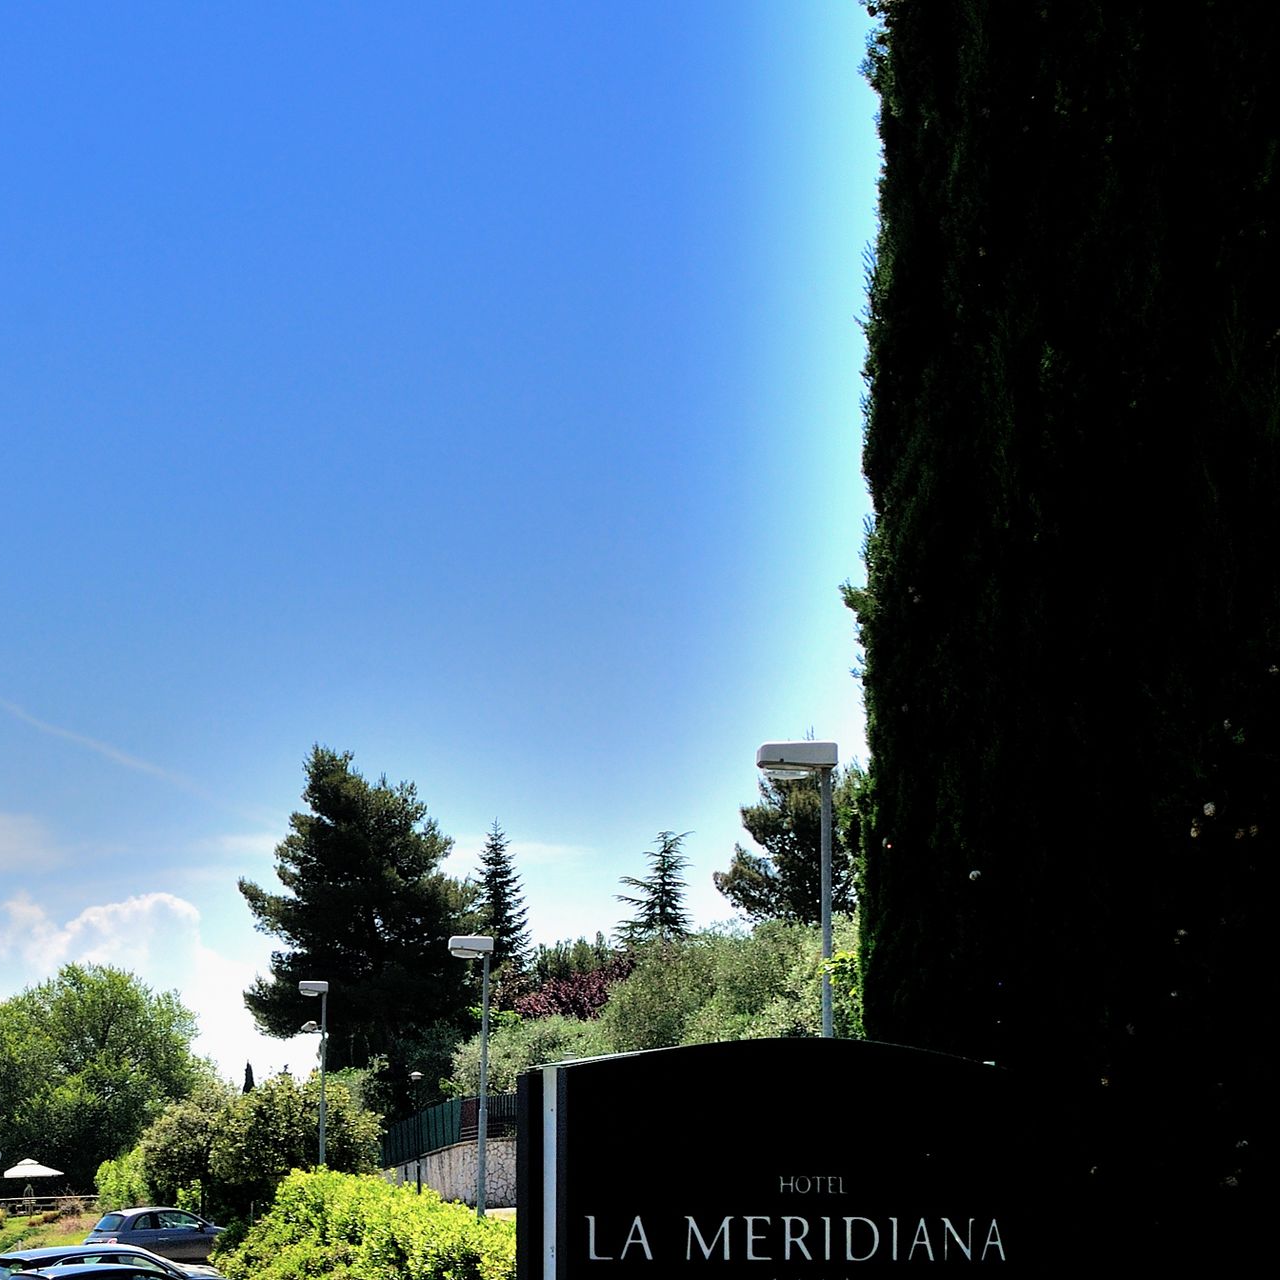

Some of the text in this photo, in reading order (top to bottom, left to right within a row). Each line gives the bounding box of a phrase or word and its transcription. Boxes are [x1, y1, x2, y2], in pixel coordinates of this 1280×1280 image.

[778, 1175, 848, 1194] HOTEL
[583, 1214, 1007, 1262] LA MERIDIANA
